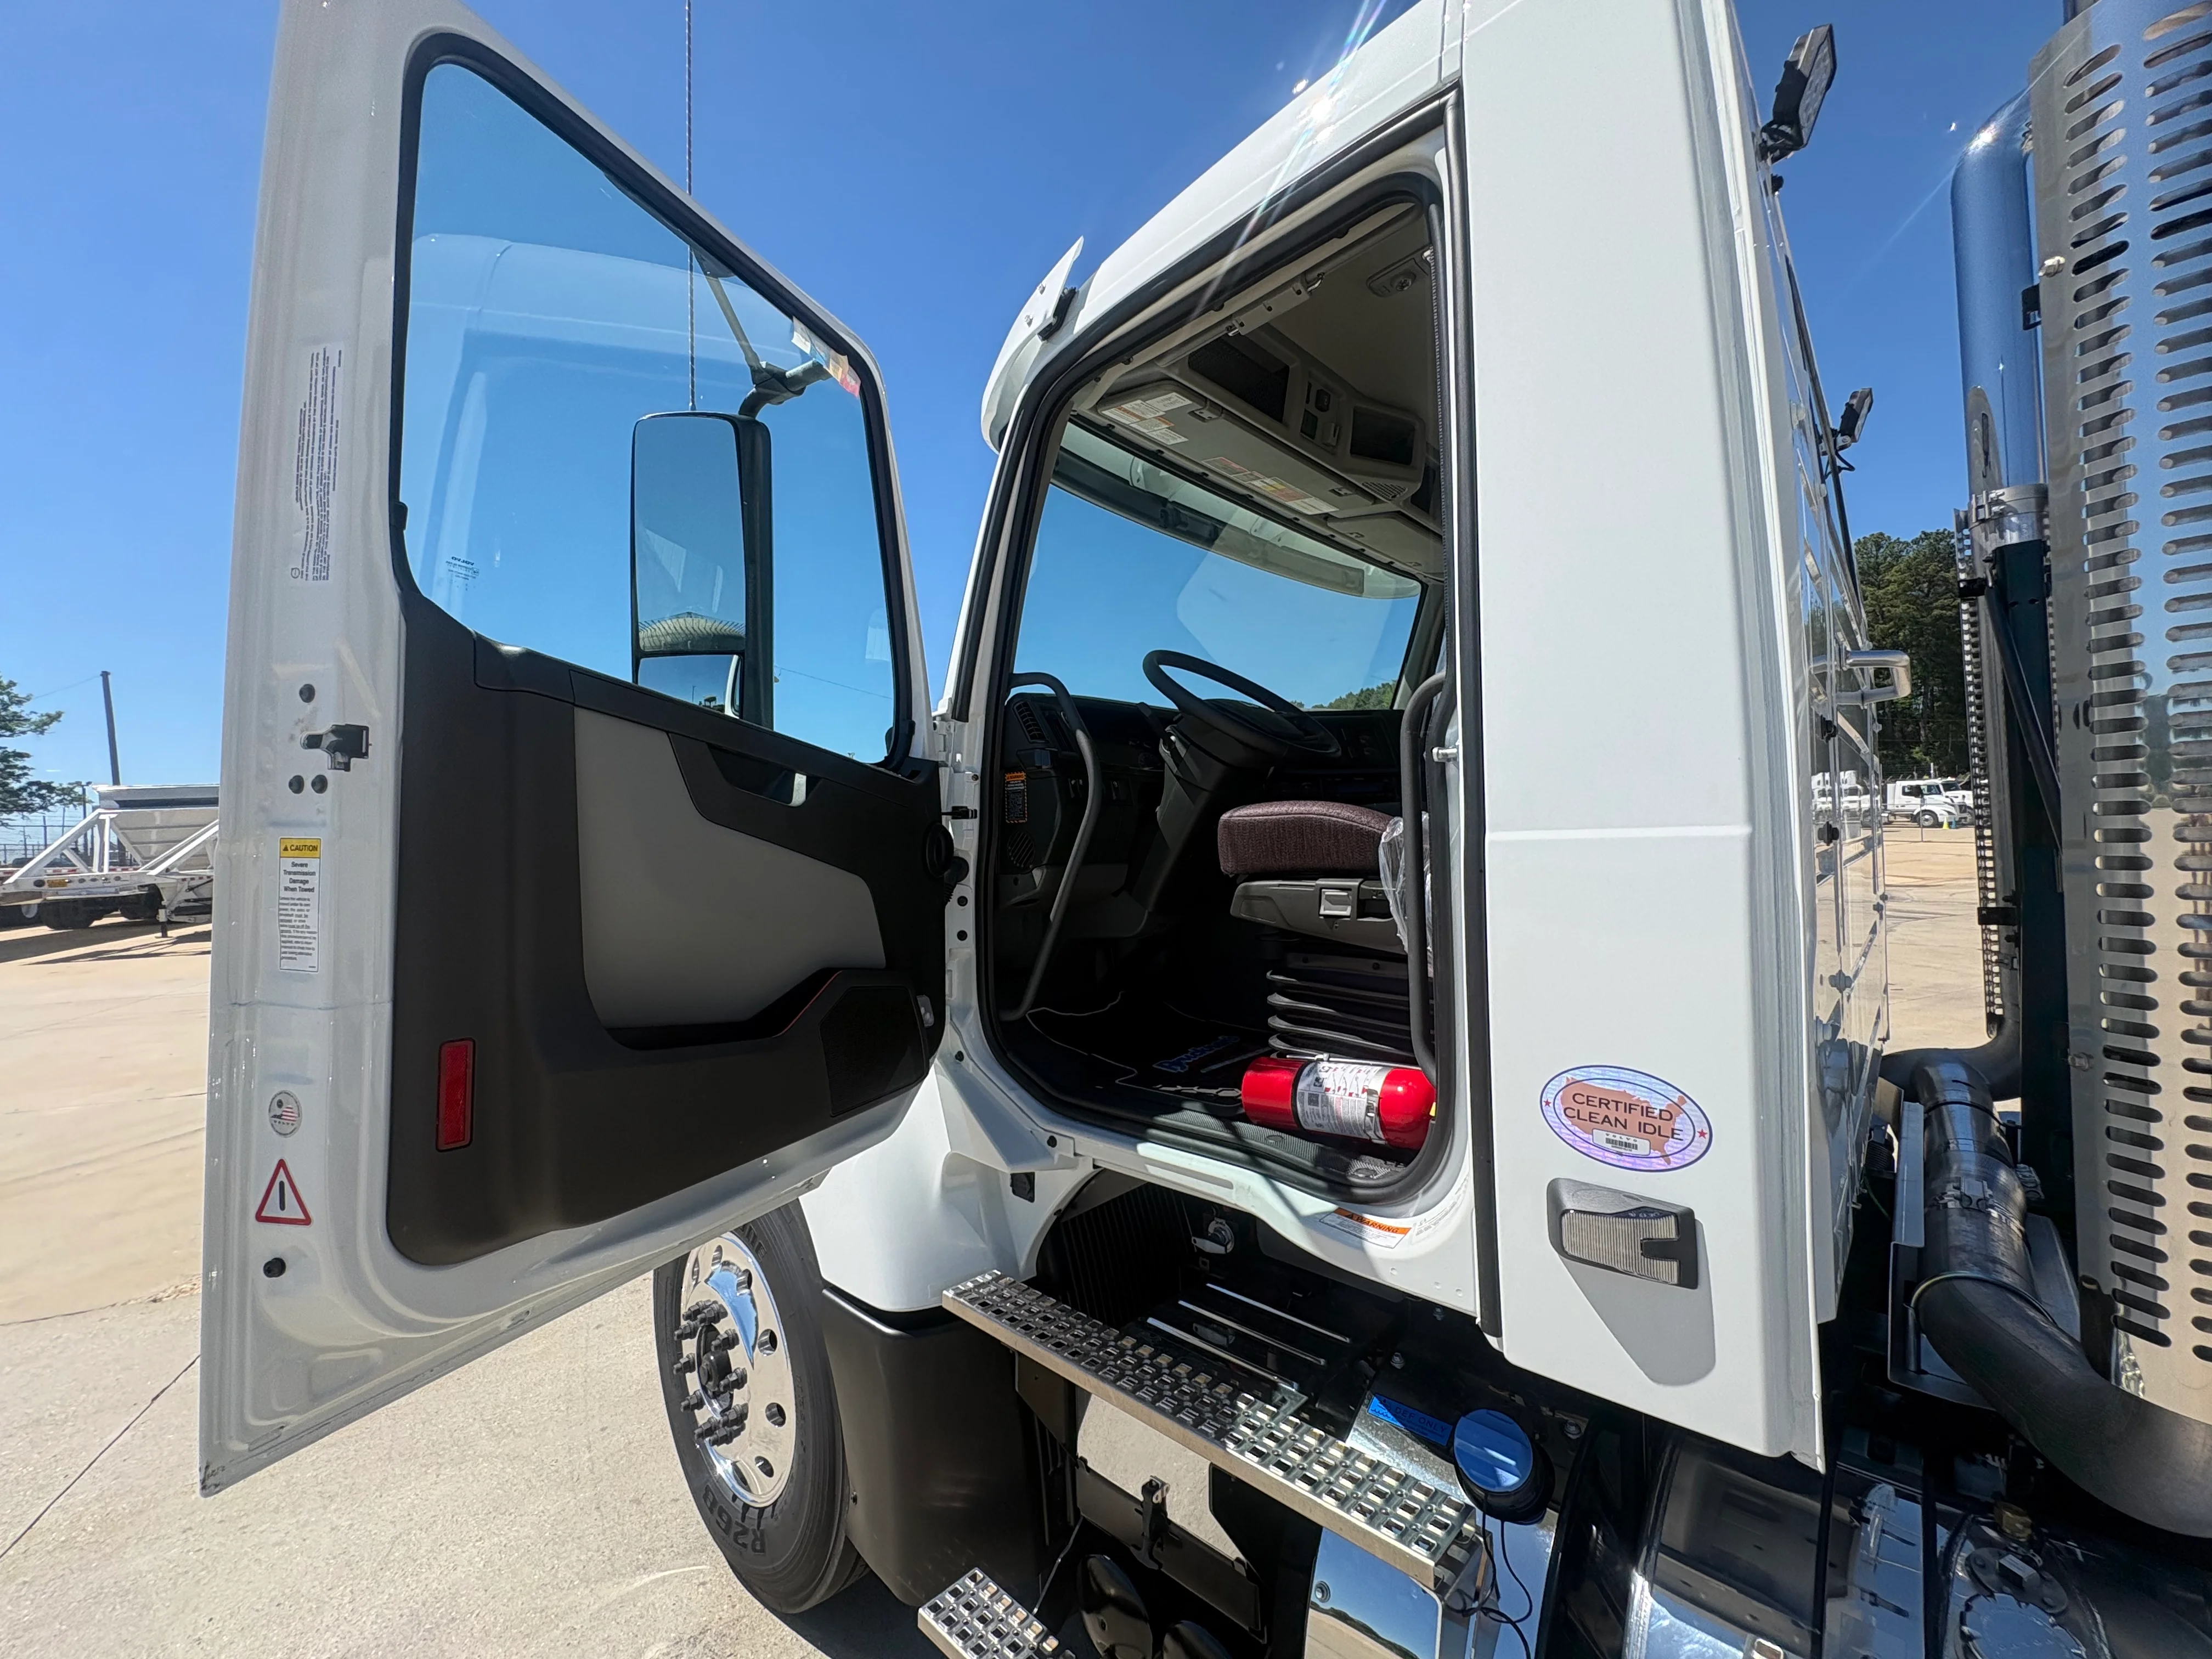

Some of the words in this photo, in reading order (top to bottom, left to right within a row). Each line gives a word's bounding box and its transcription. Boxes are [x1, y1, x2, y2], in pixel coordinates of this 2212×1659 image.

[289, 878, 309, 886] Damage
[1572, 1093, 1673, 1122] CERTIFIED
[1564, 1107, 1627, 1130] CLEAN
[1638, 1121, 1684, 1141] IDLE
[1605, 1133, 1638, 1143] VOLVO
[1357, 1216, 1400, 1234] WARNING
[1395, 1407, 1416, 1419] DEF
[1419, 1417, 1449, 1433] ONLY
[703, 1484, 766, 1554] R268
